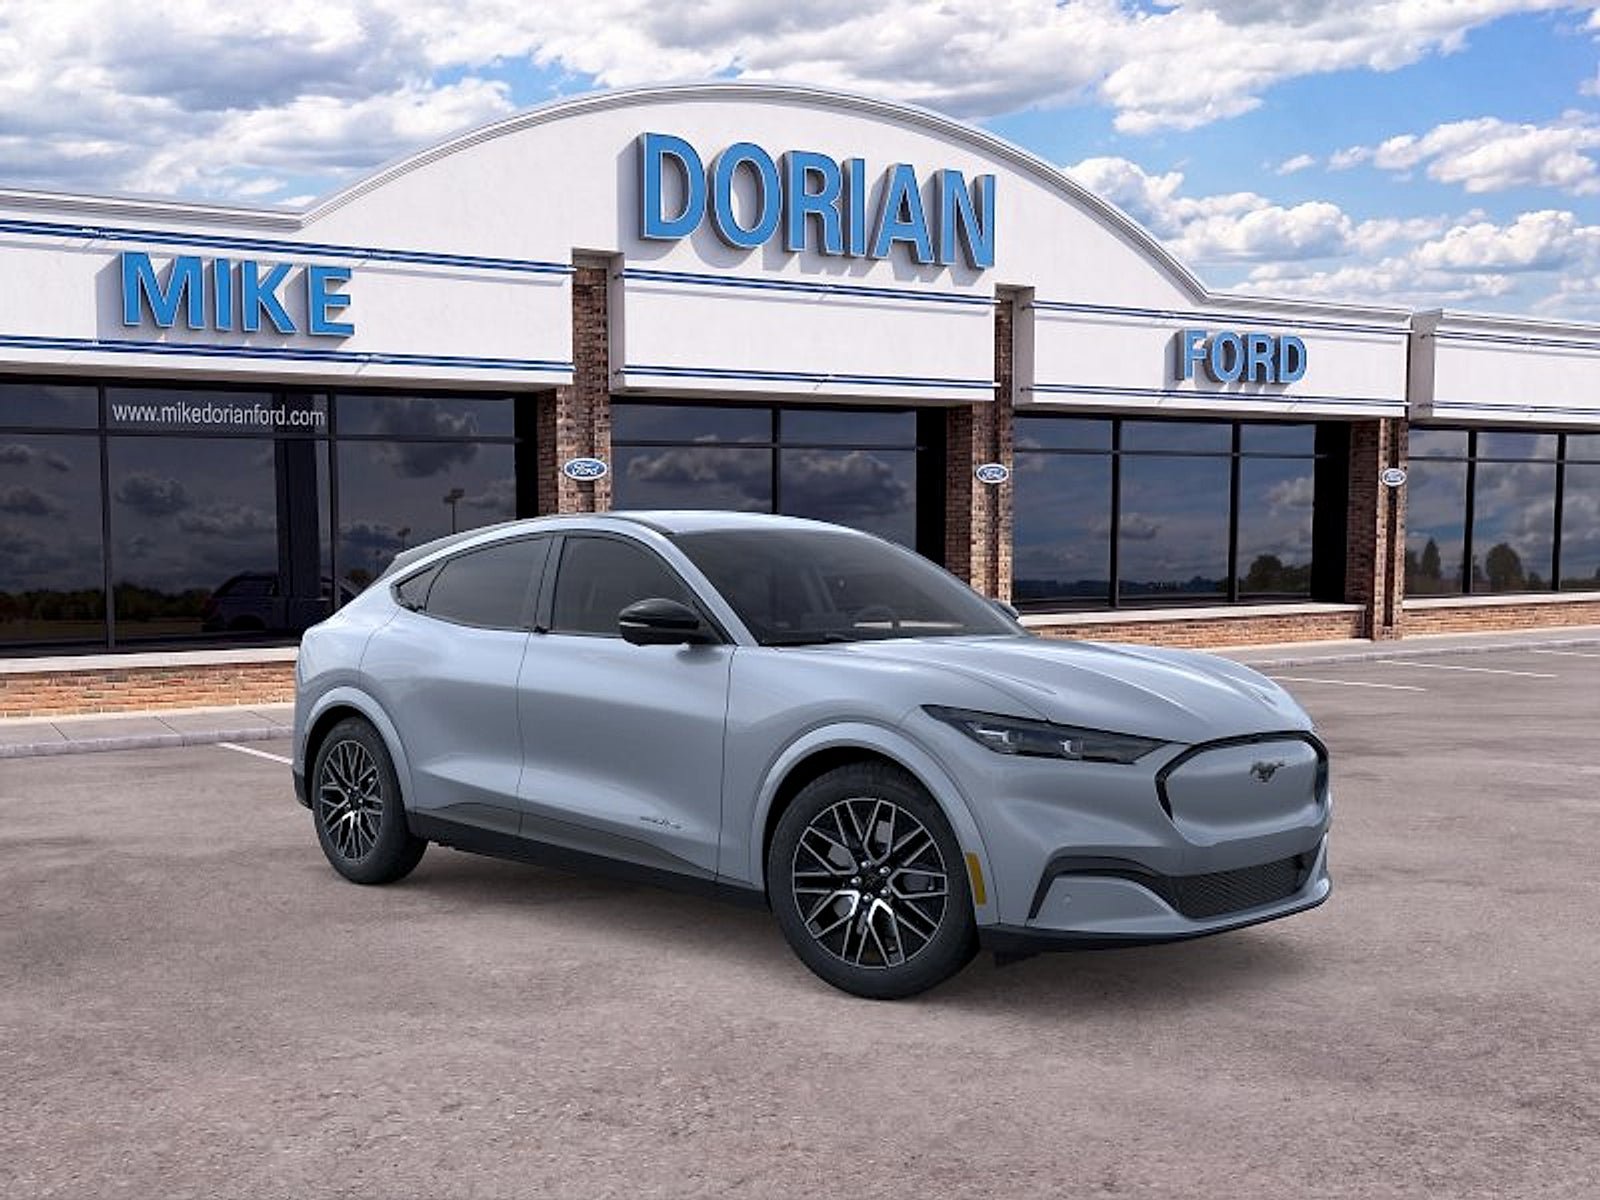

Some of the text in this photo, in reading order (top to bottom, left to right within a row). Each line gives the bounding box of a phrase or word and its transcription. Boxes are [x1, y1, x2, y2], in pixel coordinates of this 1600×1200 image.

[641, 132, 996, 268] DORIAN
[120, 250, 355, 338] MIKE
[1182, 327, 1308, 384] FORD
[112, 402, 325, 426] www.mikedorianford.com
